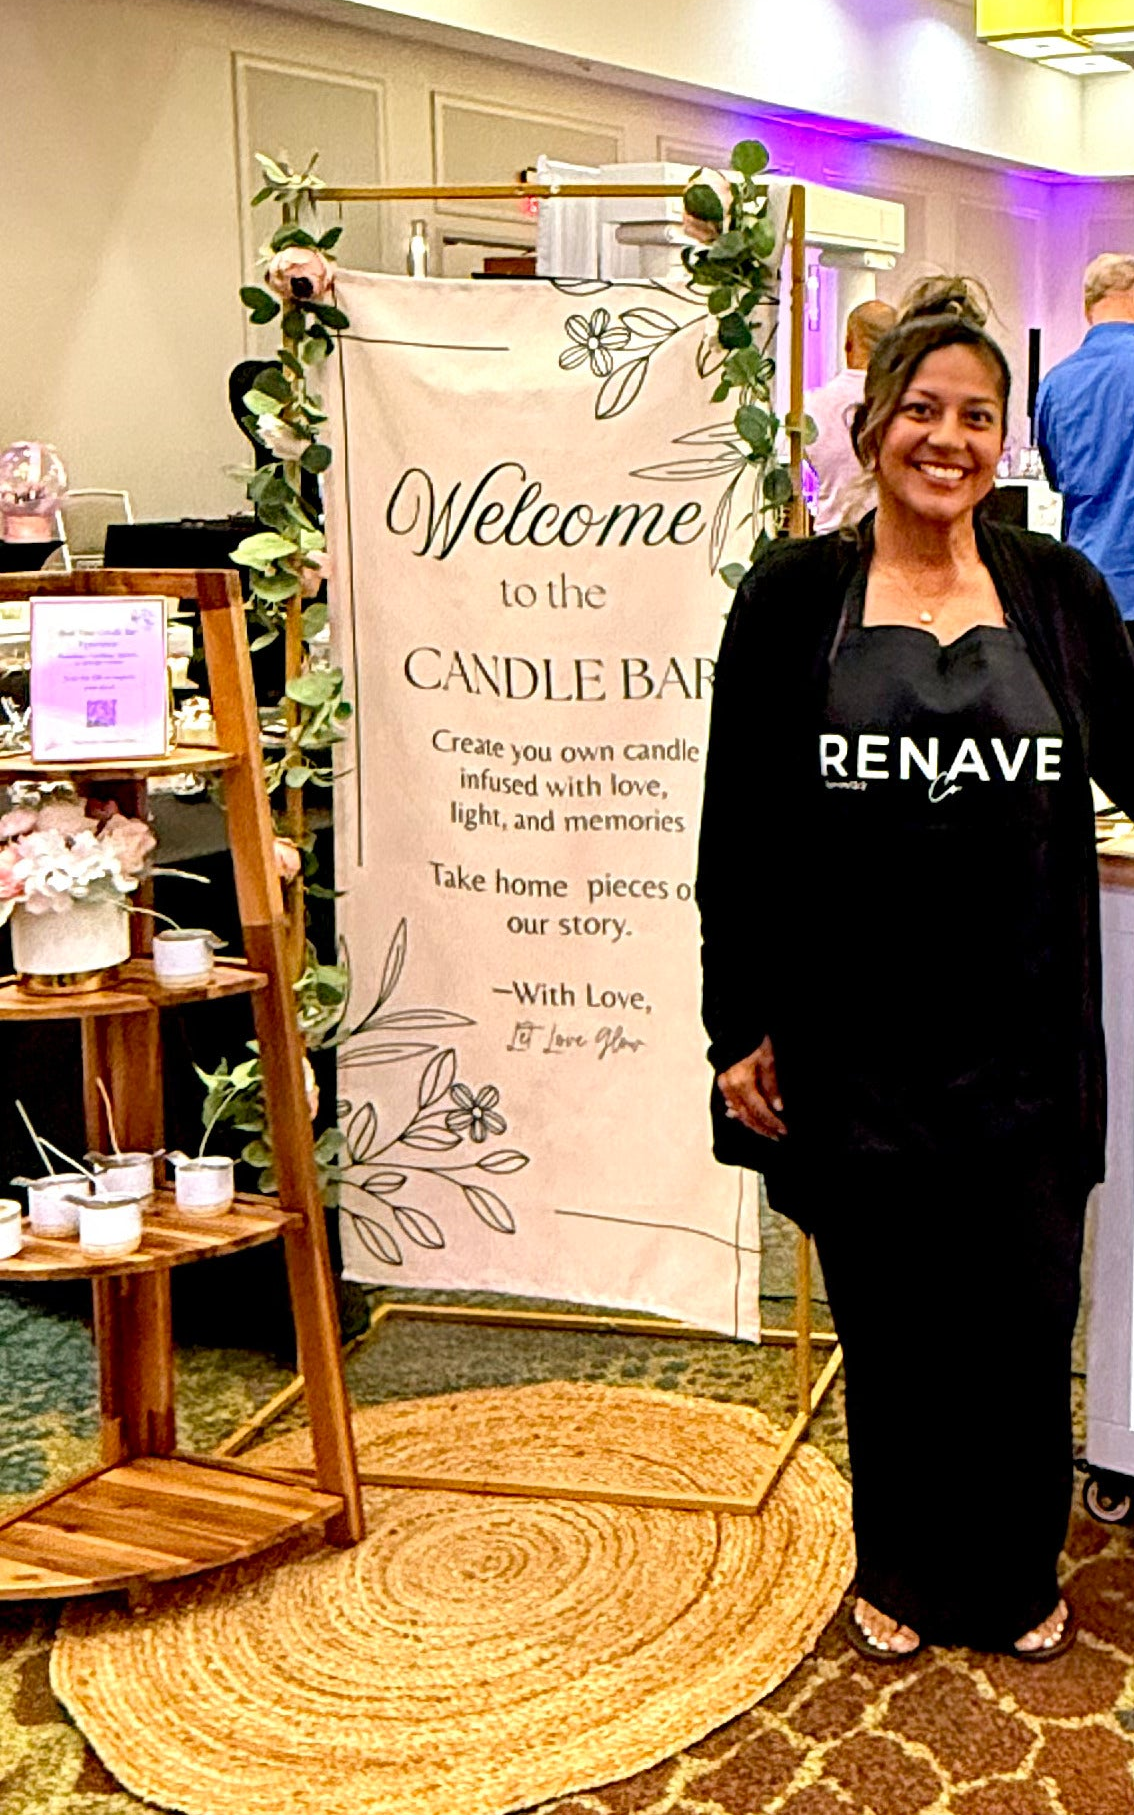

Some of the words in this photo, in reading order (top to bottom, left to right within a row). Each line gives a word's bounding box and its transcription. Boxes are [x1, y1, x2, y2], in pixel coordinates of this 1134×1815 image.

[386, 462, 705, 560] Welcome
[501, 578, 537, 608] to
[548, 572, 607, 609] the
[404, 647, 606, 701] CANDLE
[621, 657, 715, 700] BAR
[432, 729, 505, 759] Create
[511, 743, 552, 766] you
[560, 745, 614, 763] own
[623, 738, 700, 763] candle
[819, 734, 1063, 782] RENAVE
[460, 768, 538, 797] infused
[546, 774, 602, 797] with
[611, 774, 669, 800] love,
[450, 801, 508, 831] light,
[515, 806, 555, 831] and
[564, 810, 685, 833] memories
[429, 861, 487, 892] Take
[496, 870, 568, 898] home
[588, 873, 669, 904] pieces
[677, 885, 694, 901] o
[507, 914, 549, 936] our
[559, 915, 633, 943] story.
[587, 983, 652, 1014] Love,
[543, 1022, 587, 1054] Love
